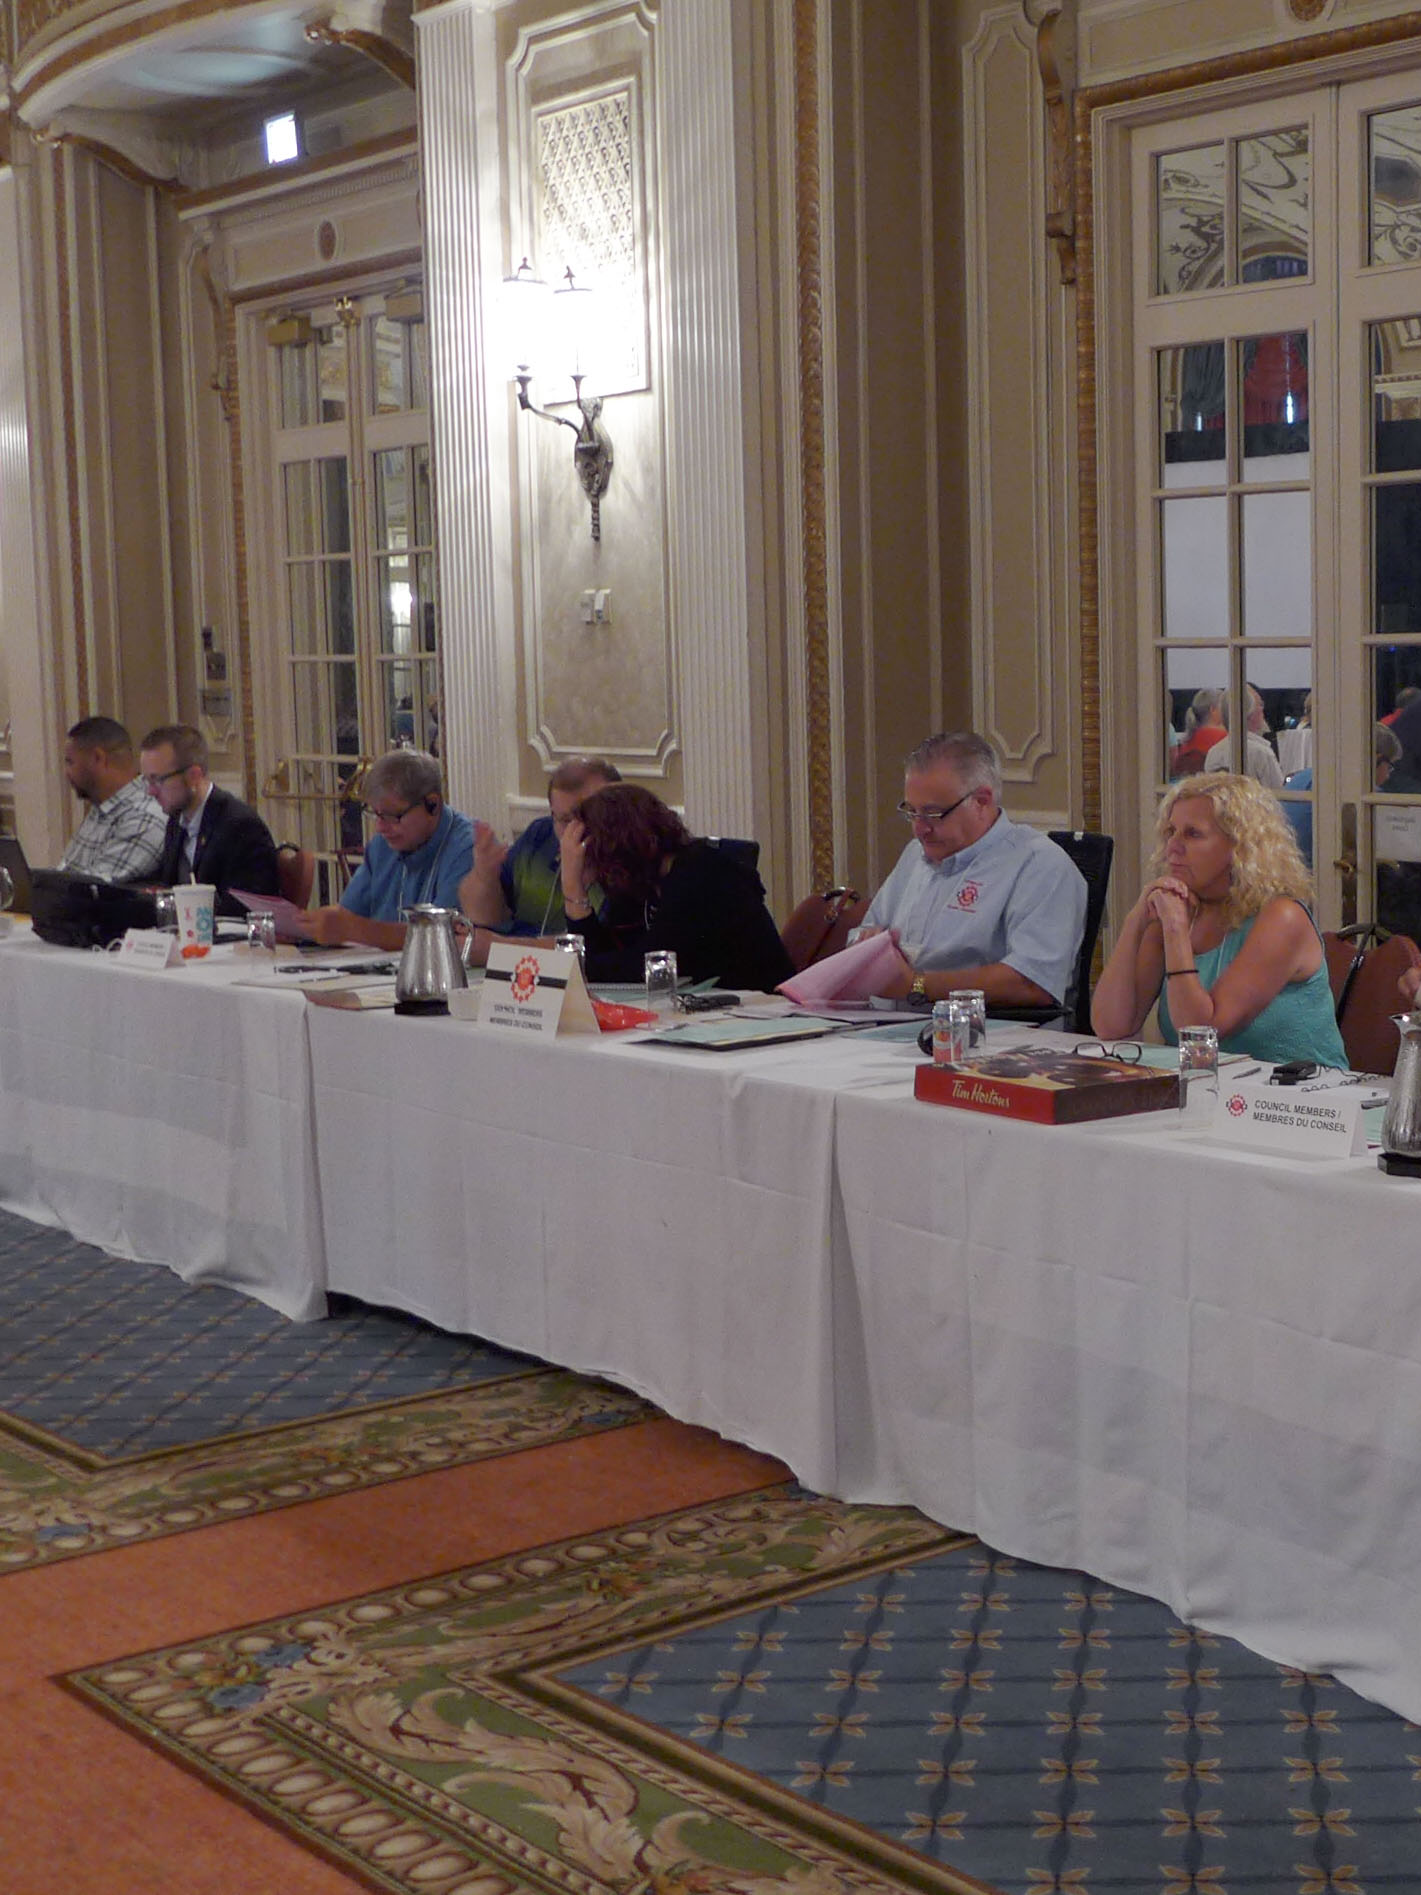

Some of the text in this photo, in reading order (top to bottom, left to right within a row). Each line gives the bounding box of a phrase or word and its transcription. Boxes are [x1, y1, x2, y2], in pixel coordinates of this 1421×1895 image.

[952, 1079, 1010, 1108] Tim Hortons
[1254, 1099, 1291, 1113] COUNCIL
[1293, 1104, 1336, 1119] MEMBERS
[1252, 1111, 1347, 1133] MEMBRES DU CONSEIL
